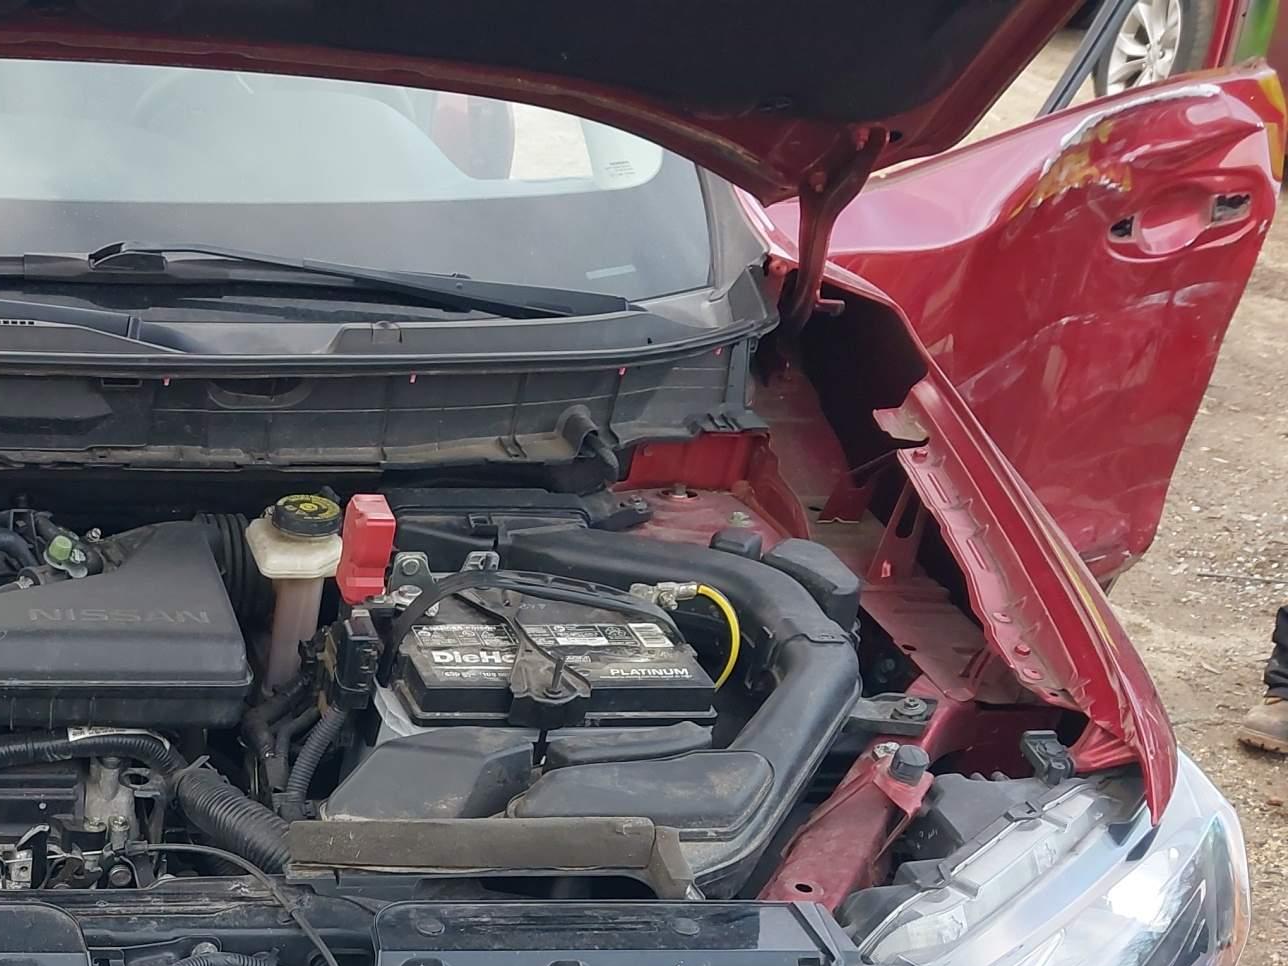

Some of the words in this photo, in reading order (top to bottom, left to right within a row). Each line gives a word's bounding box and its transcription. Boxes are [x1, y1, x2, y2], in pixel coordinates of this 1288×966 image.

[28, 608, 210, 624] NISSAN
[432, 650, 516, 664] DieH
[610, 667, 690, 677] PLATINUM
